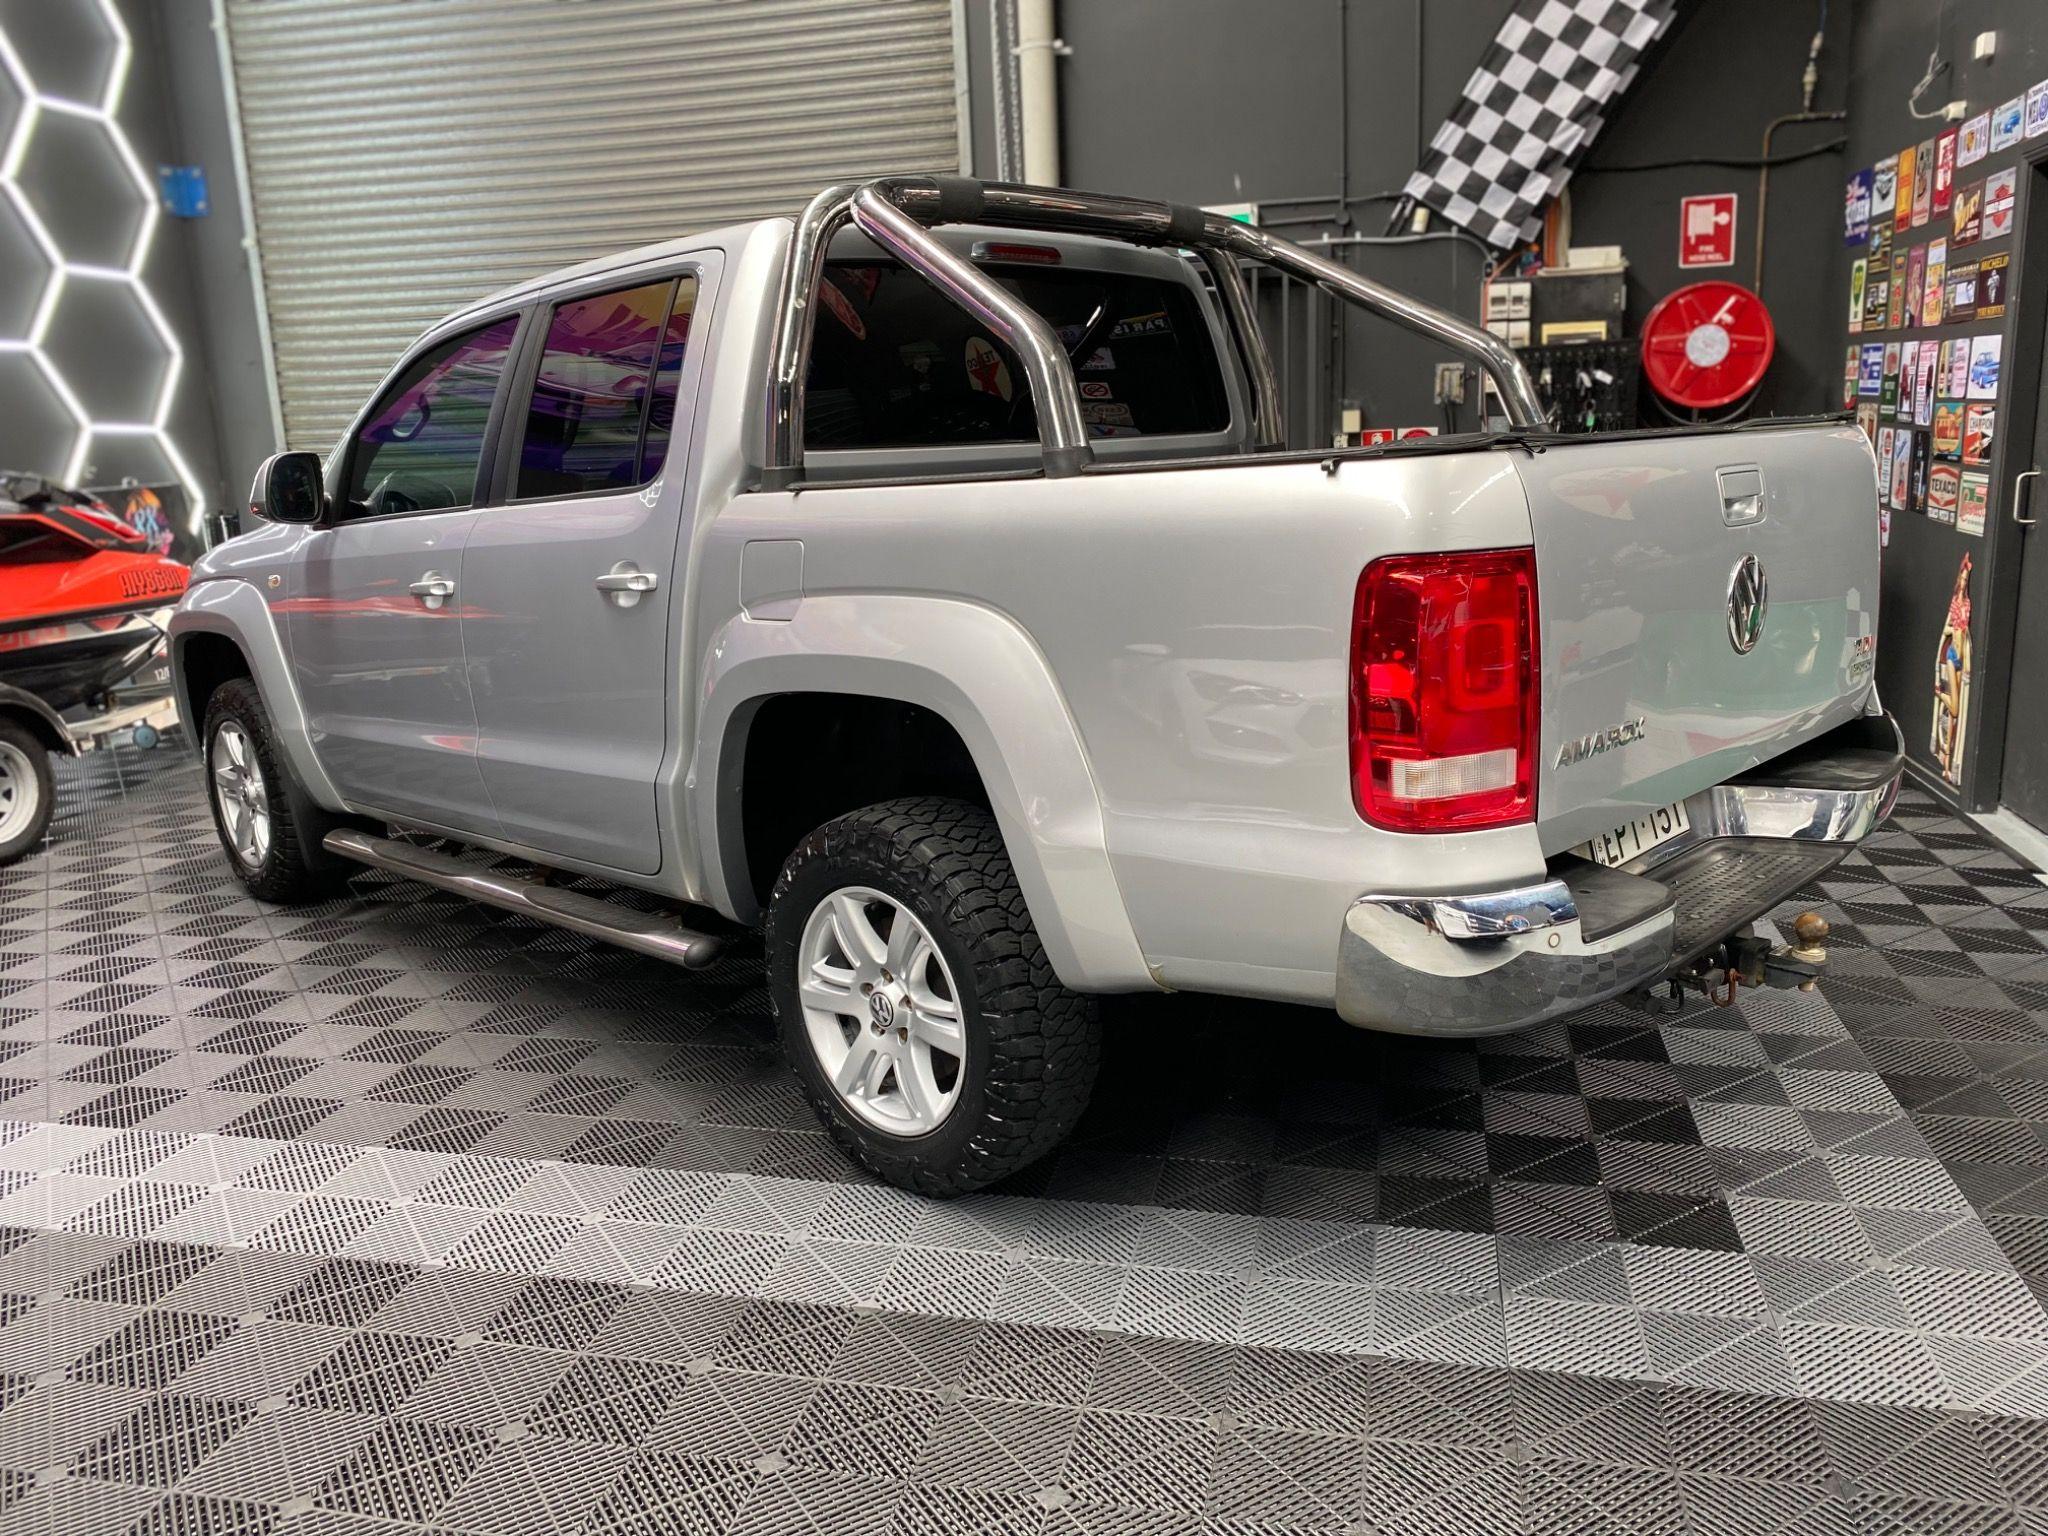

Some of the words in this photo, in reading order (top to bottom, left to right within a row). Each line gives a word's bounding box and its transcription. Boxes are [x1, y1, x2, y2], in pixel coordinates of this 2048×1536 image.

[1969, 415, 1993, 432] CHAMPION
[1931, 478, 1957, 496] TEXACO
[1552, 716, 1646, 772] AMAROK
